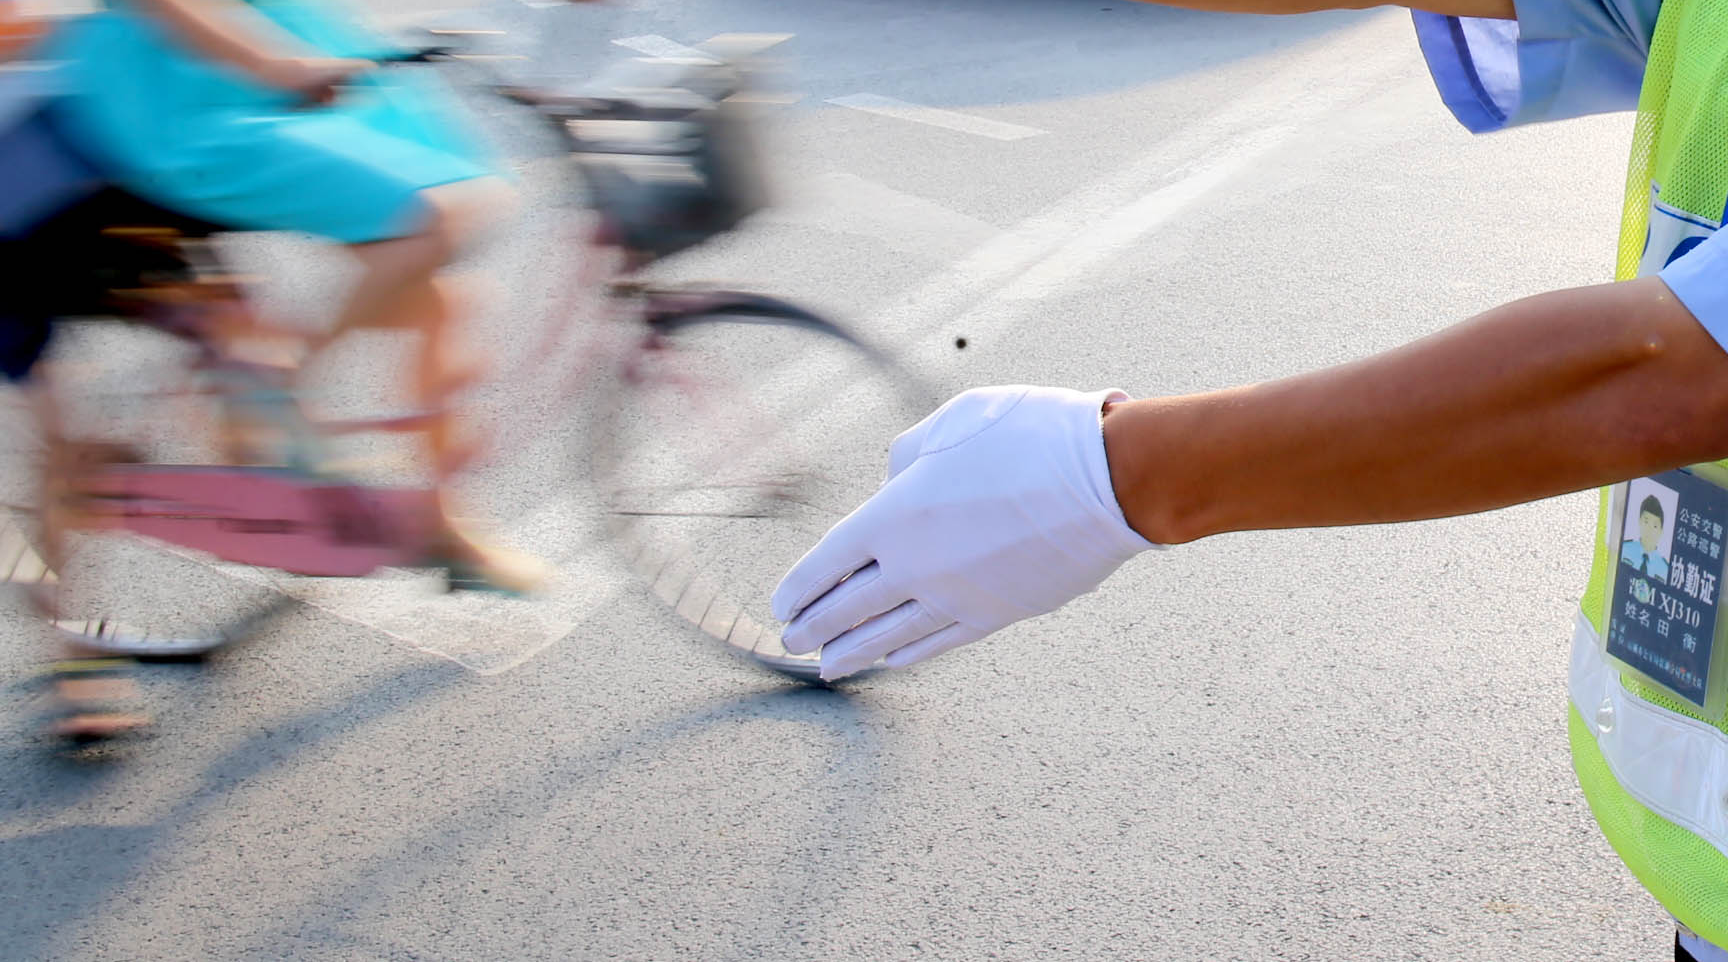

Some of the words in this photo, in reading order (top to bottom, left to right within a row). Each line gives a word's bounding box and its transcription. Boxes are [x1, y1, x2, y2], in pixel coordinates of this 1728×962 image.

[1680, 508, 1723, 539] 公安交警
[1670, 554, 1716, 605] 协勤证
[1625, 601, 1650, 627] 姓名
[1657, 619, 1669, 638] 田
[1658, 592, 1700, 628] XJ310
